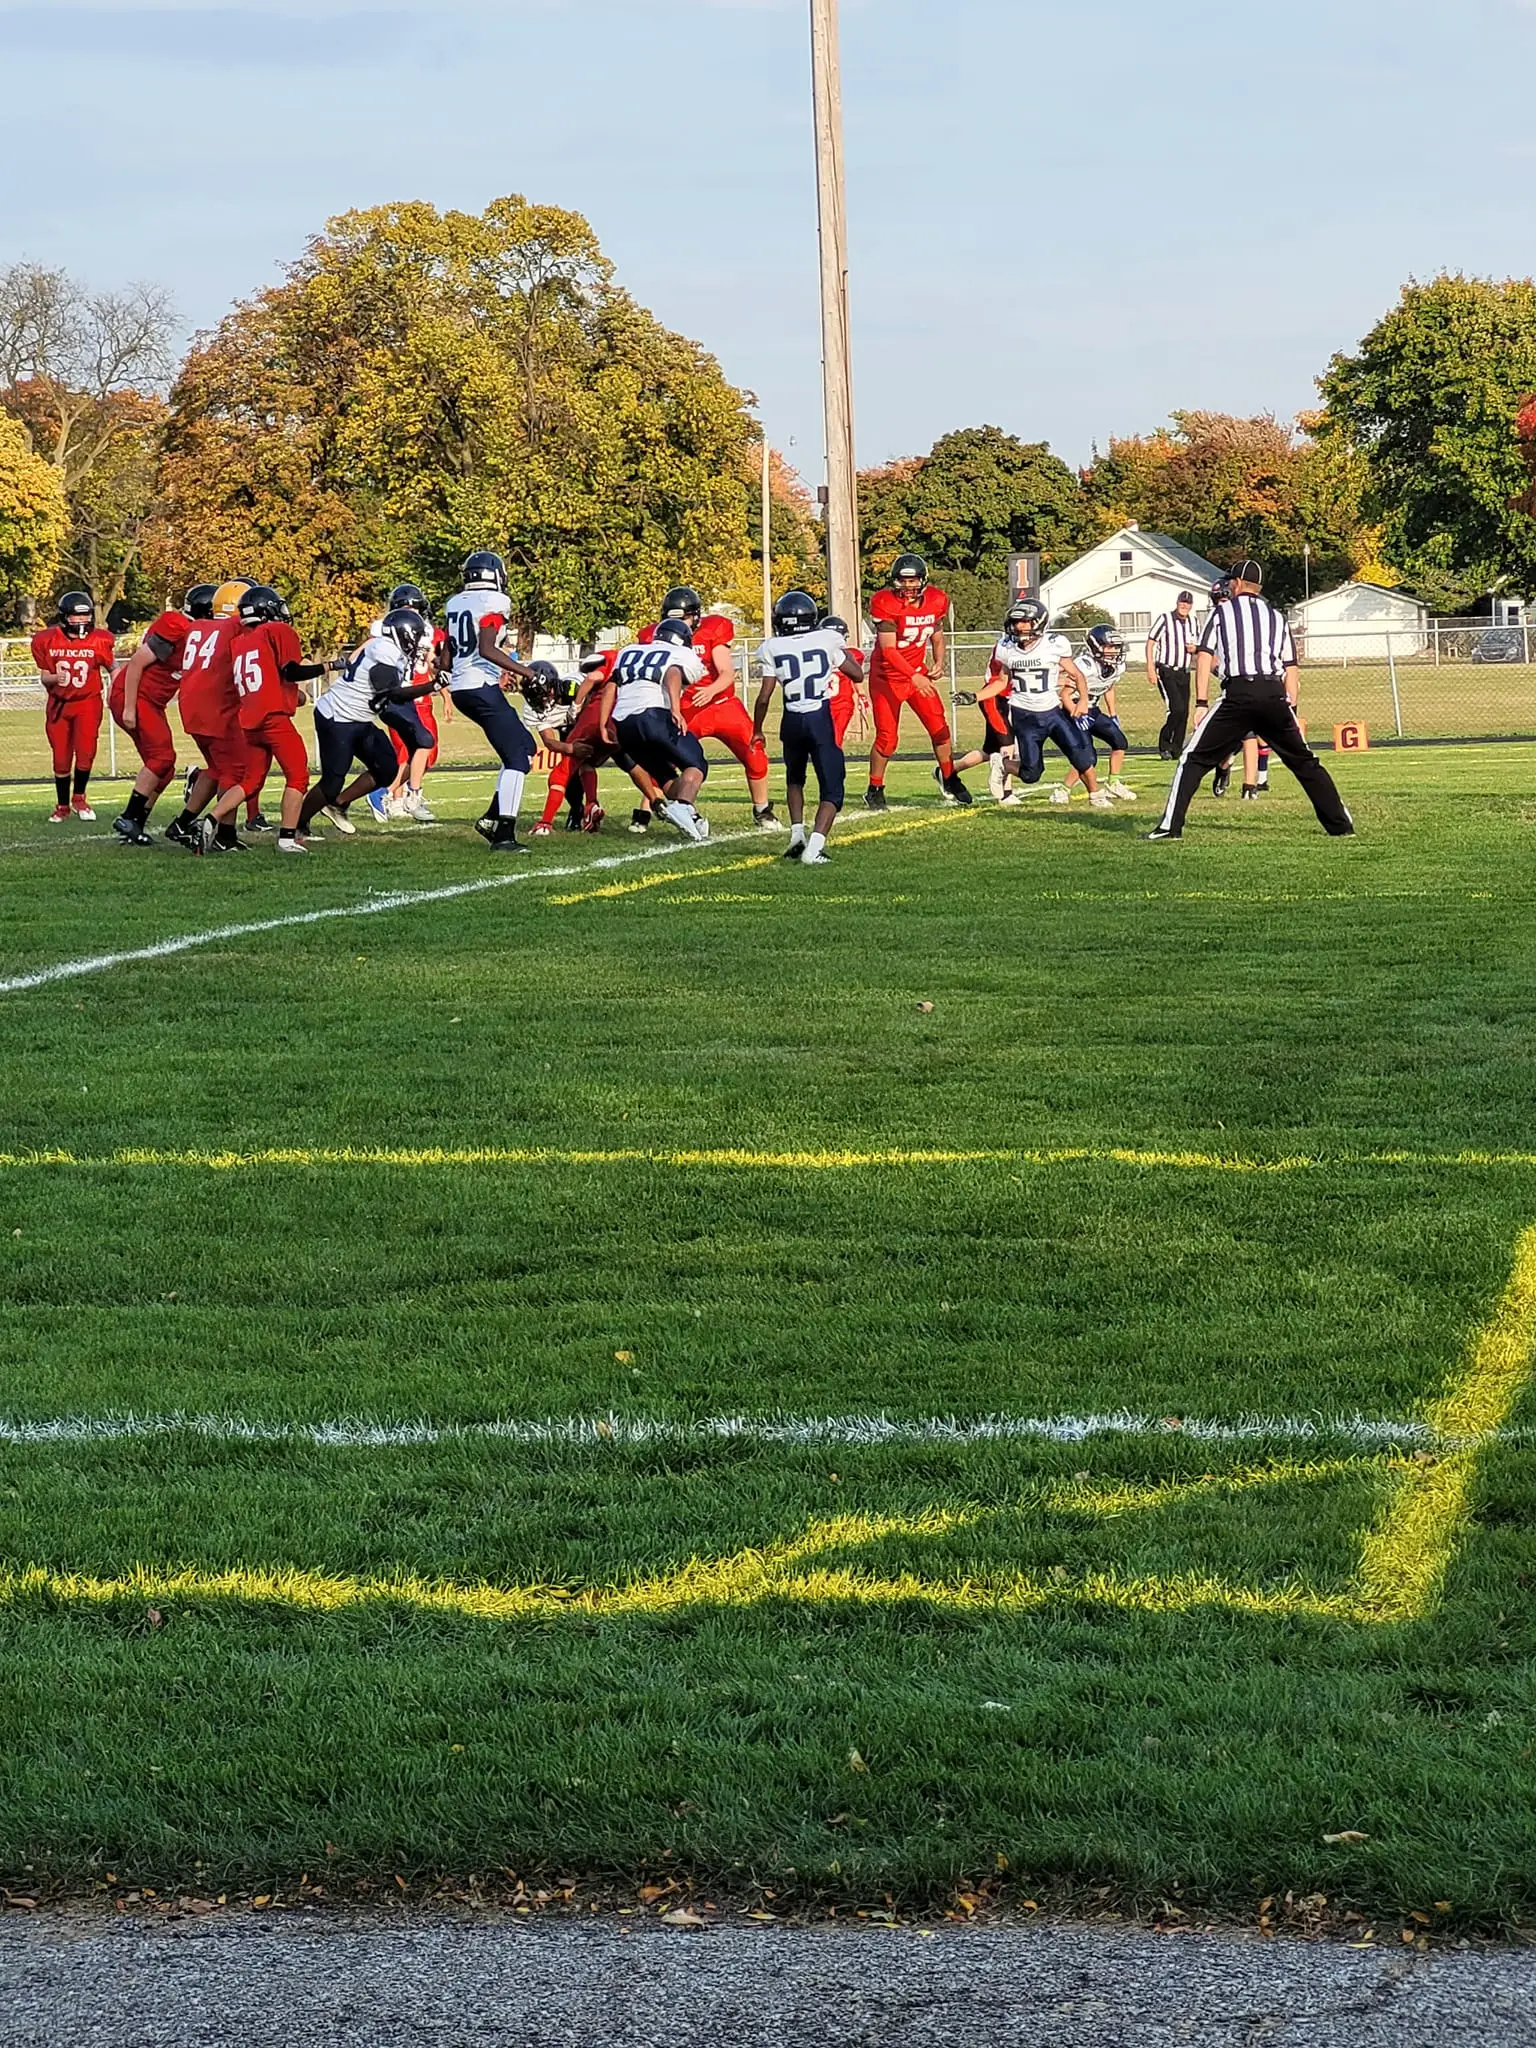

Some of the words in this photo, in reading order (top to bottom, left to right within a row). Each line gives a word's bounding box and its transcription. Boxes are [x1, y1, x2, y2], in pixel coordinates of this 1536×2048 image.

[1016, 559, 1029, 588] 1
[49, 649, 95, 658] WILDCATS
[182, 630, 220, 670] 64
[1011, 659, 1042, 669] HAWKS
[56, 660, 89, 688] 63
[233, 649, 262, 696] 45
[619, 650, 671, 685] 88
[773, 649, 830, 702] 22
[1011, 668, 1050, 694] 53
[1341, 726, 1359, 748] G
